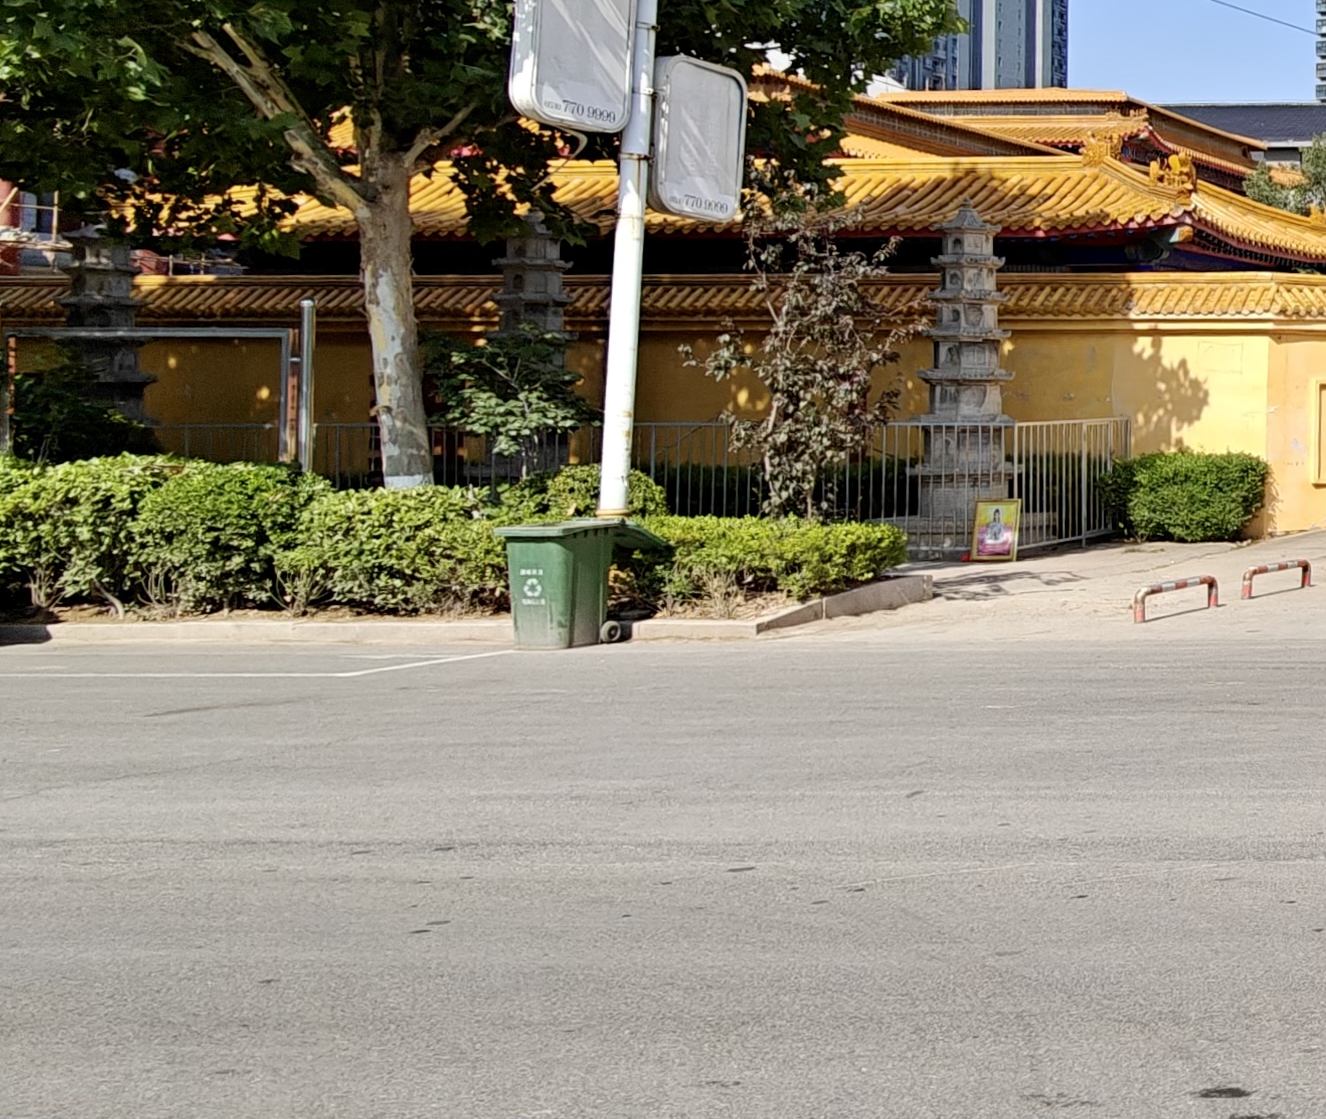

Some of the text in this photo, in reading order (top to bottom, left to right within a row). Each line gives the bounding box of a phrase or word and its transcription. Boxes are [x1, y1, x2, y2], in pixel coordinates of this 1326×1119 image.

[562, 99, 585, 116] 770
[587, 105, 616, 123] 9999
[684, 194, 702, 209] 770
